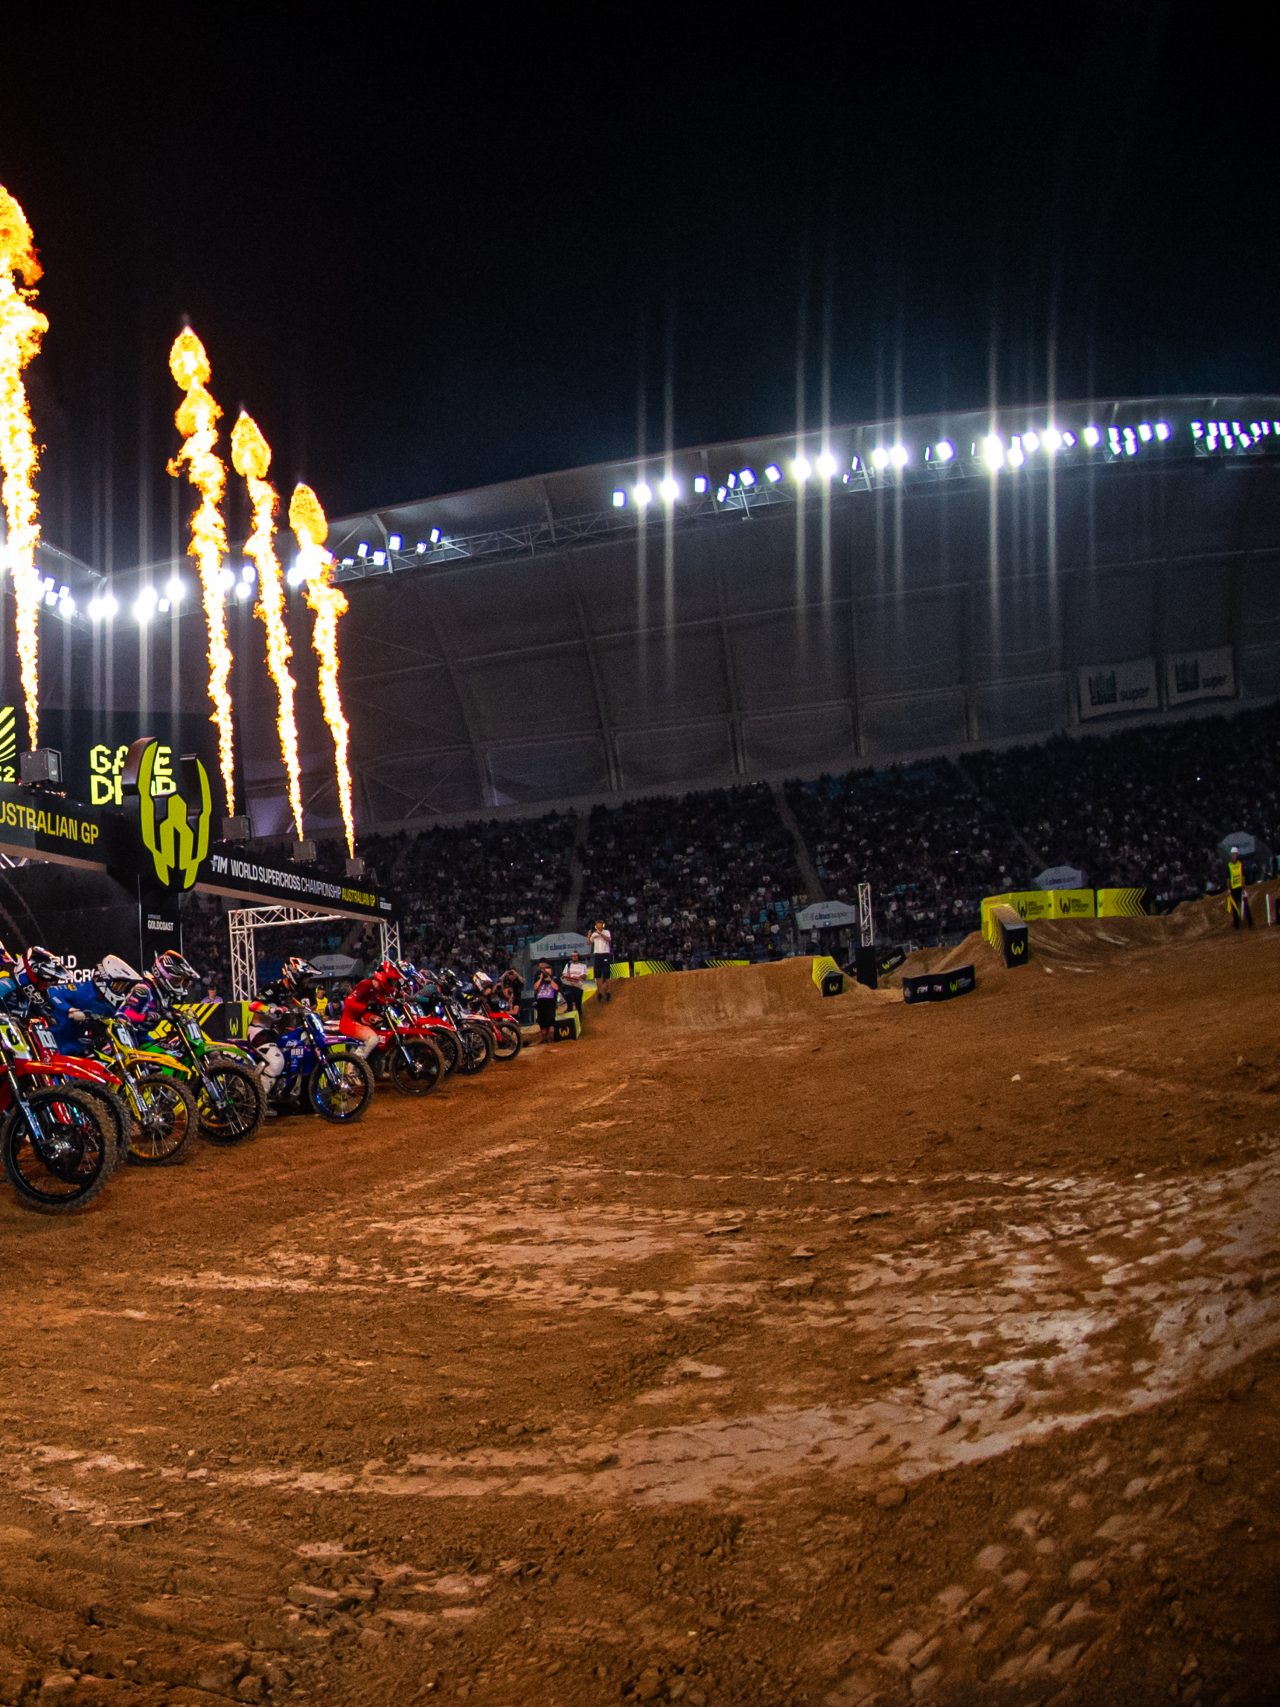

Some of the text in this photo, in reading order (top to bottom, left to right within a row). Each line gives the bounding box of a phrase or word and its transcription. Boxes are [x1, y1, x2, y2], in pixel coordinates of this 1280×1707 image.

[1119, 687, 1150, 703] super
[89, 744, 173, 775] GAE
[80, 822, 99, 845] GP
[210, 854, 228, 874] FIM
[230, 859, 259, 881] WORLD
[258, 867, 301, 891] SUPERCROSS
[300, 877, 341, 899] CHAMPIONSHIP
